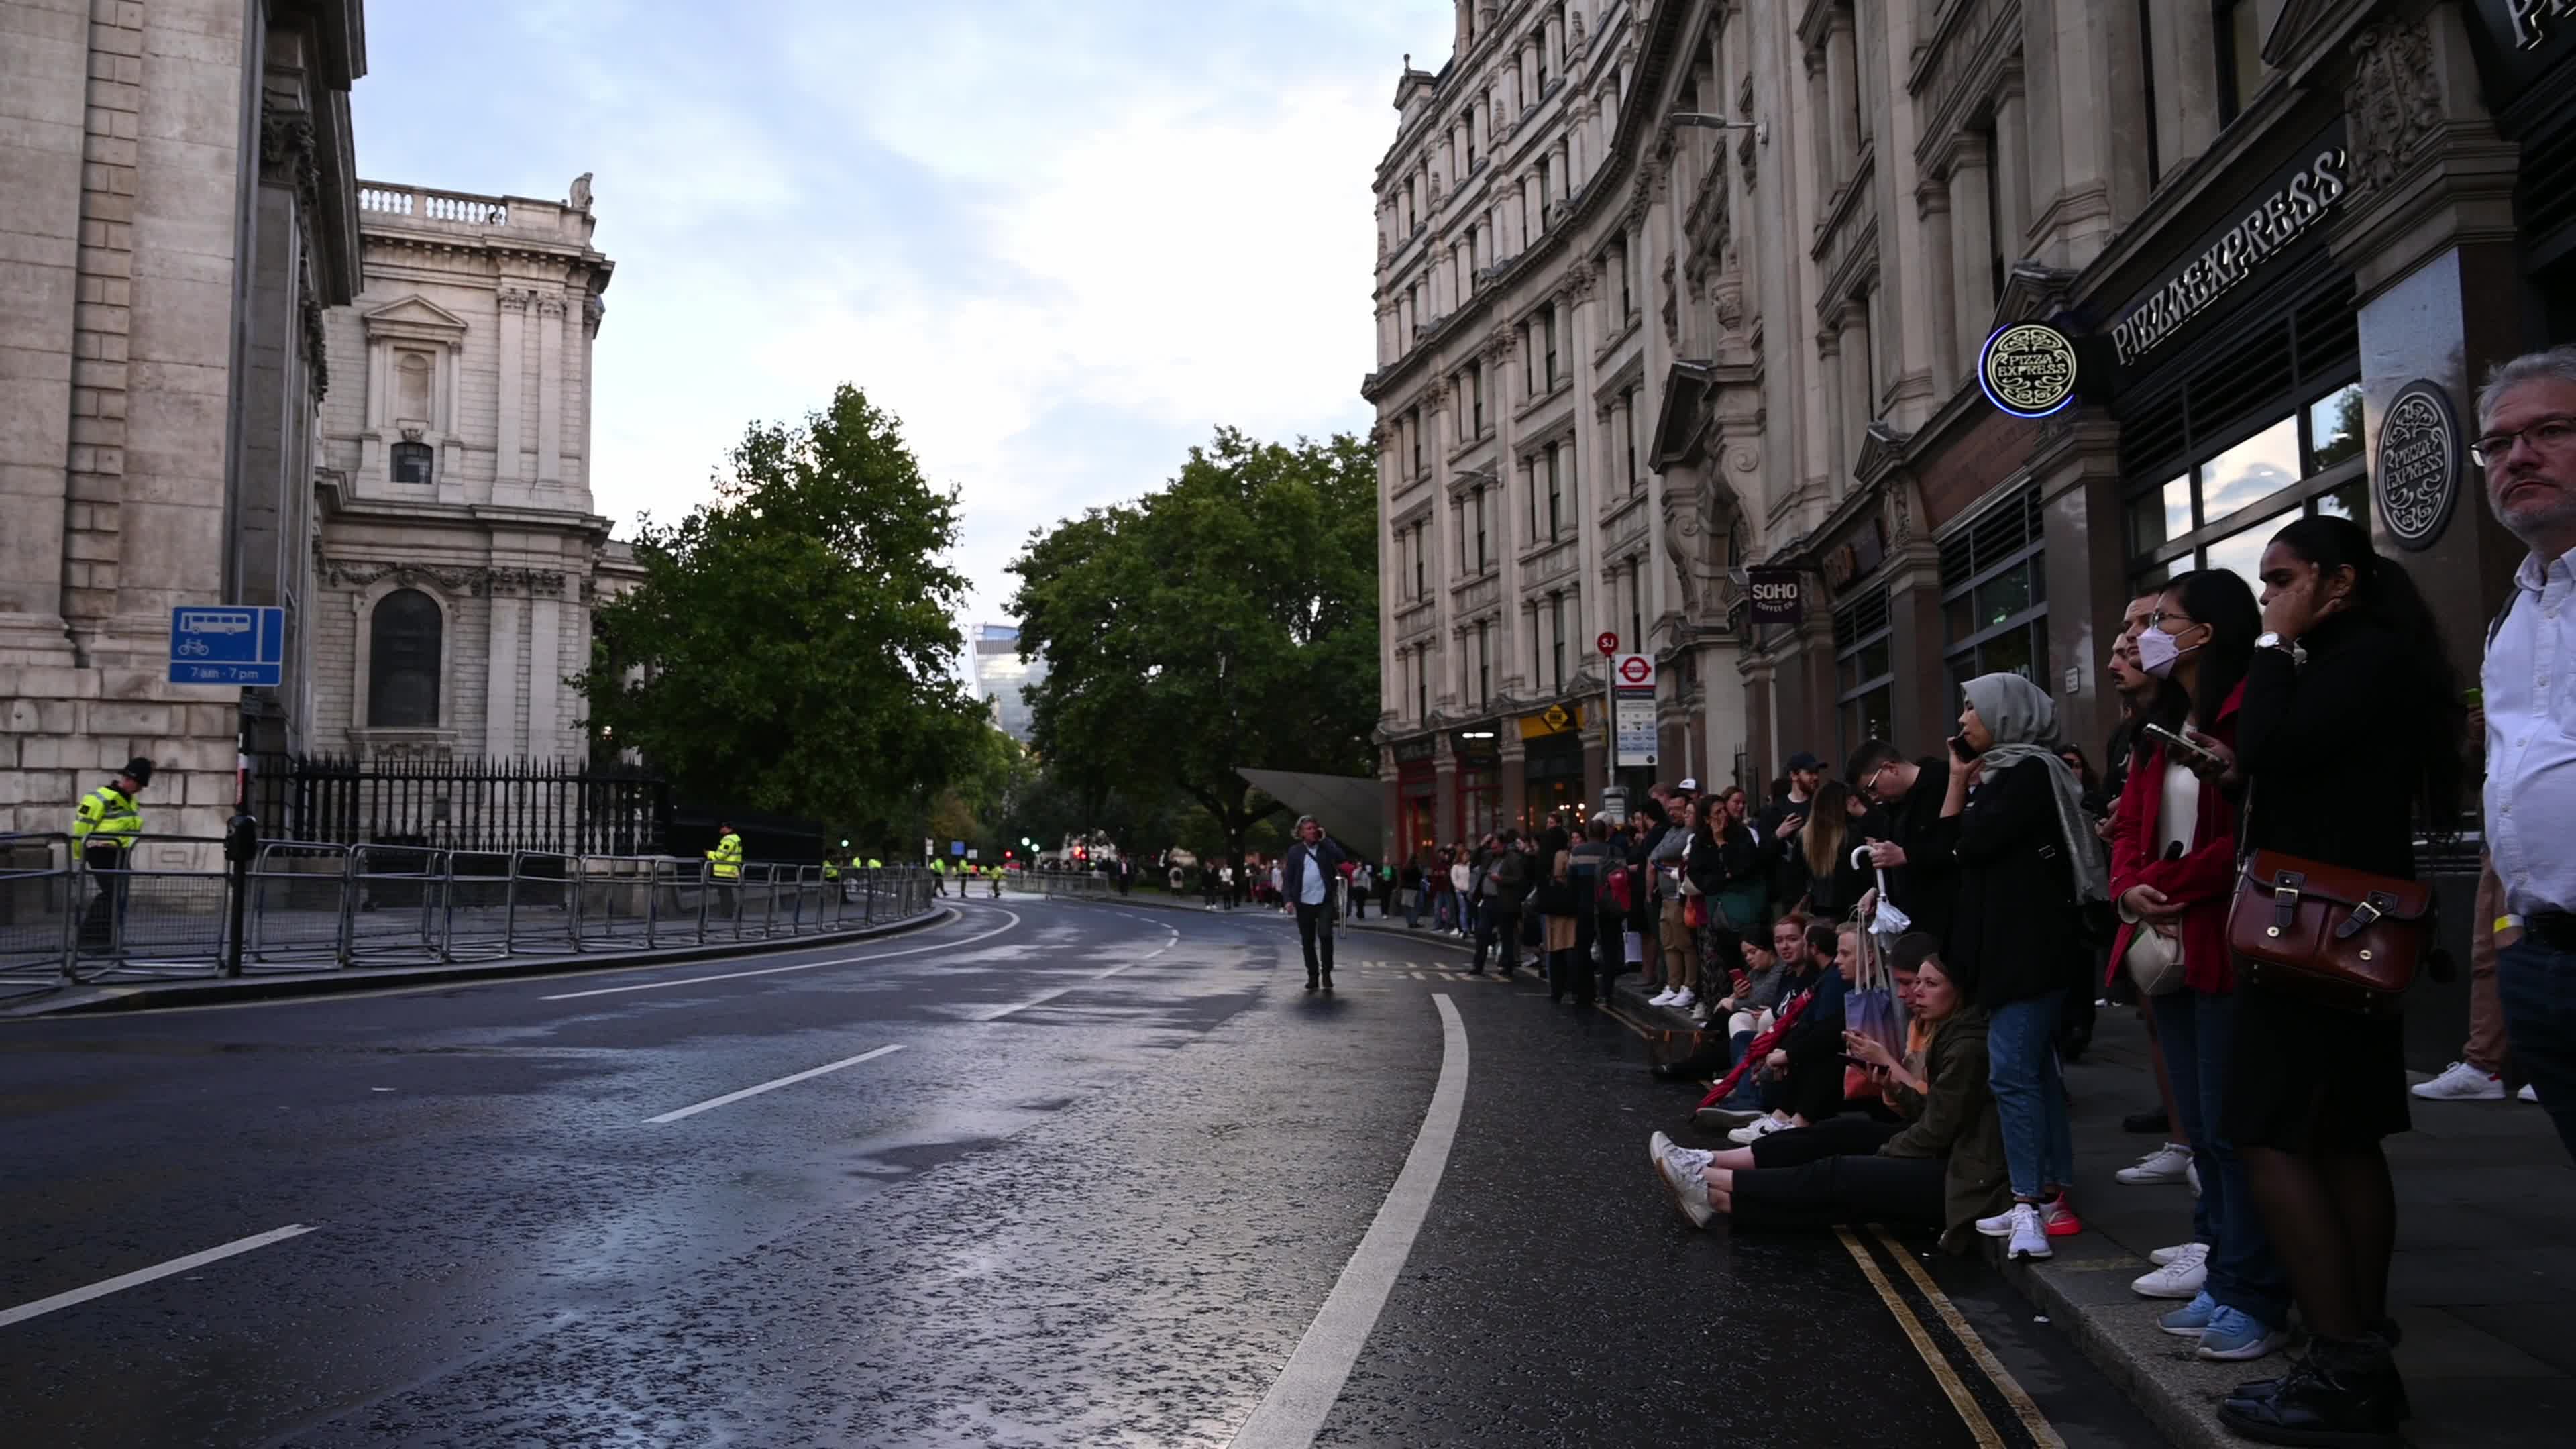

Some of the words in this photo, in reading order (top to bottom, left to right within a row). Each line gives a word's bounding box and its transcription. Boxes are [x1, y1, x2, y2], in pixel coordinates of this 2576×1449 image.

[2112, 148, 2345, 365] PIZZAEXPRESS
[2010, 354, 2053, 366] PIZZA
[1998, 363, 2067, 376] EXPRESS
[2395, 440, 2431, 468] PIZZA
[2386, 451, 2443, 490] EXPRESS
[1752, 583, 1798, 600] SOHO
[1756, 602, 1782, 612] COFFEE
[1601, 637, 1614, 648] SJ
